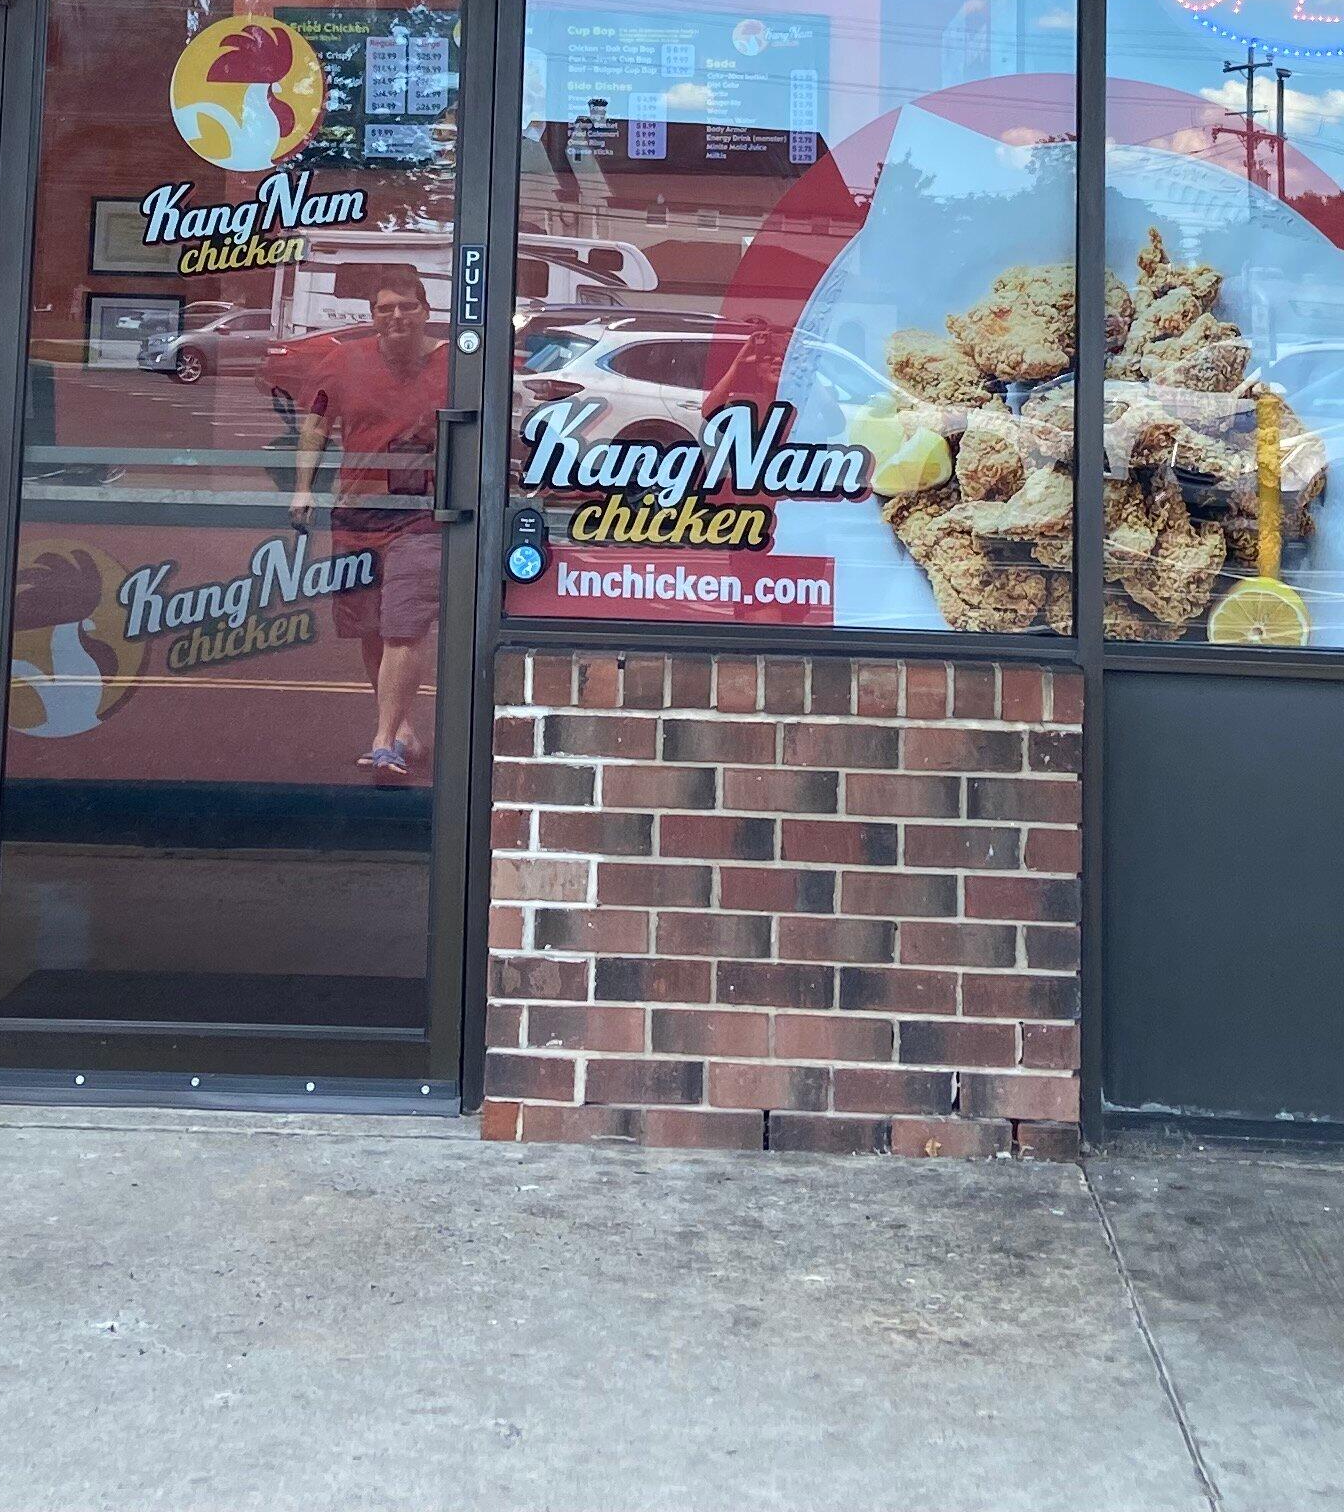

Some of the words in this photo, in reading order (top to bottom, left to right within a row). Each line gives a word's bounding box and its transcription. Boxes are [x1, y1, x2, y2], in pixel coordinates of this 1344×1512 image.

[567, 26, 590, 38] Cup
[705, 59, 736, 68] Soda
[143, 184, 258, 245] Kang
[258, 172, 365, 228] Nam
[178, 234, 305, 274] chicken
[464, 249, 480, 321] PULL
[523, 402, 701, 508] Kang
[701, 405, 866, 493] Nam
[571, 493, 766, 545] chicken
[120, 565, 251, 639] Kang
[251, 533, 373, 608] Nam
[557, 562, 831, 606] knchicken.com
[170, 611, 313, 670] chicken
